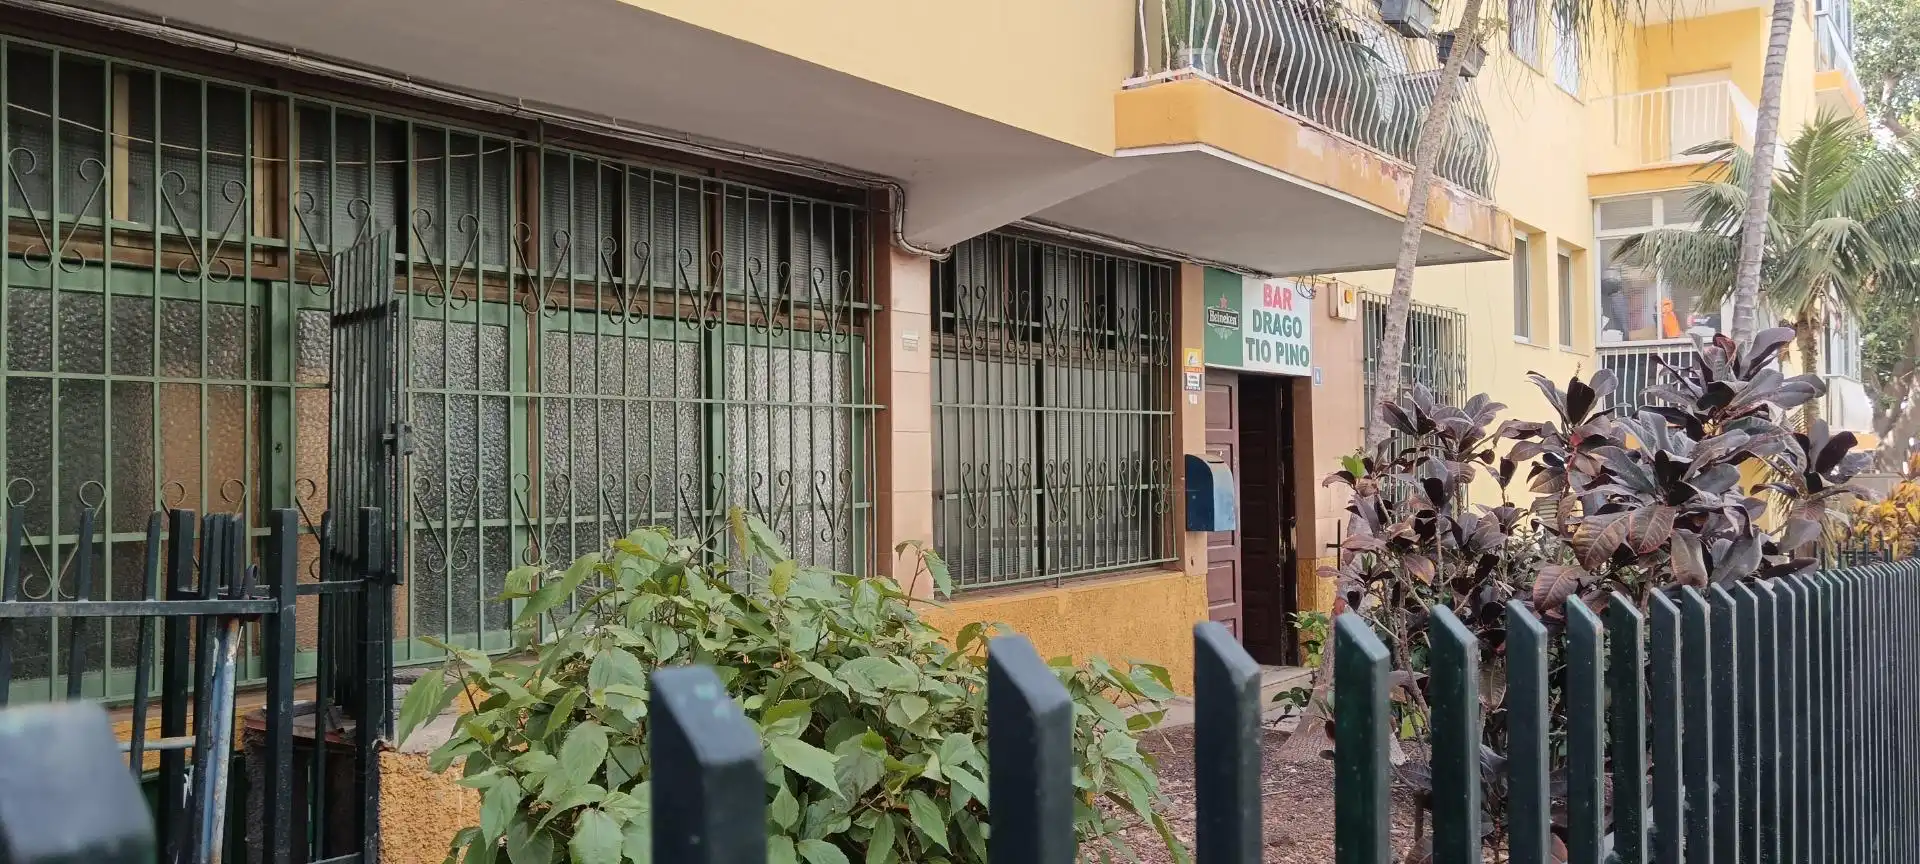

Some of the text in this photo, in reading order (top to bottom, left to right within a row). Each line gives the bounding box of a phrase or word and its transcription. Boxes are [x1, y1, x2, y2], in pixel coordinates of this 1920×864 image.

[1263, 283, 1292, 311] BAR
[1209, 310, 1237, 326] Heineken
[1252, 309, 1303, 339] DRAGO
[1245, 337, 1310, 368] TIO PINO
